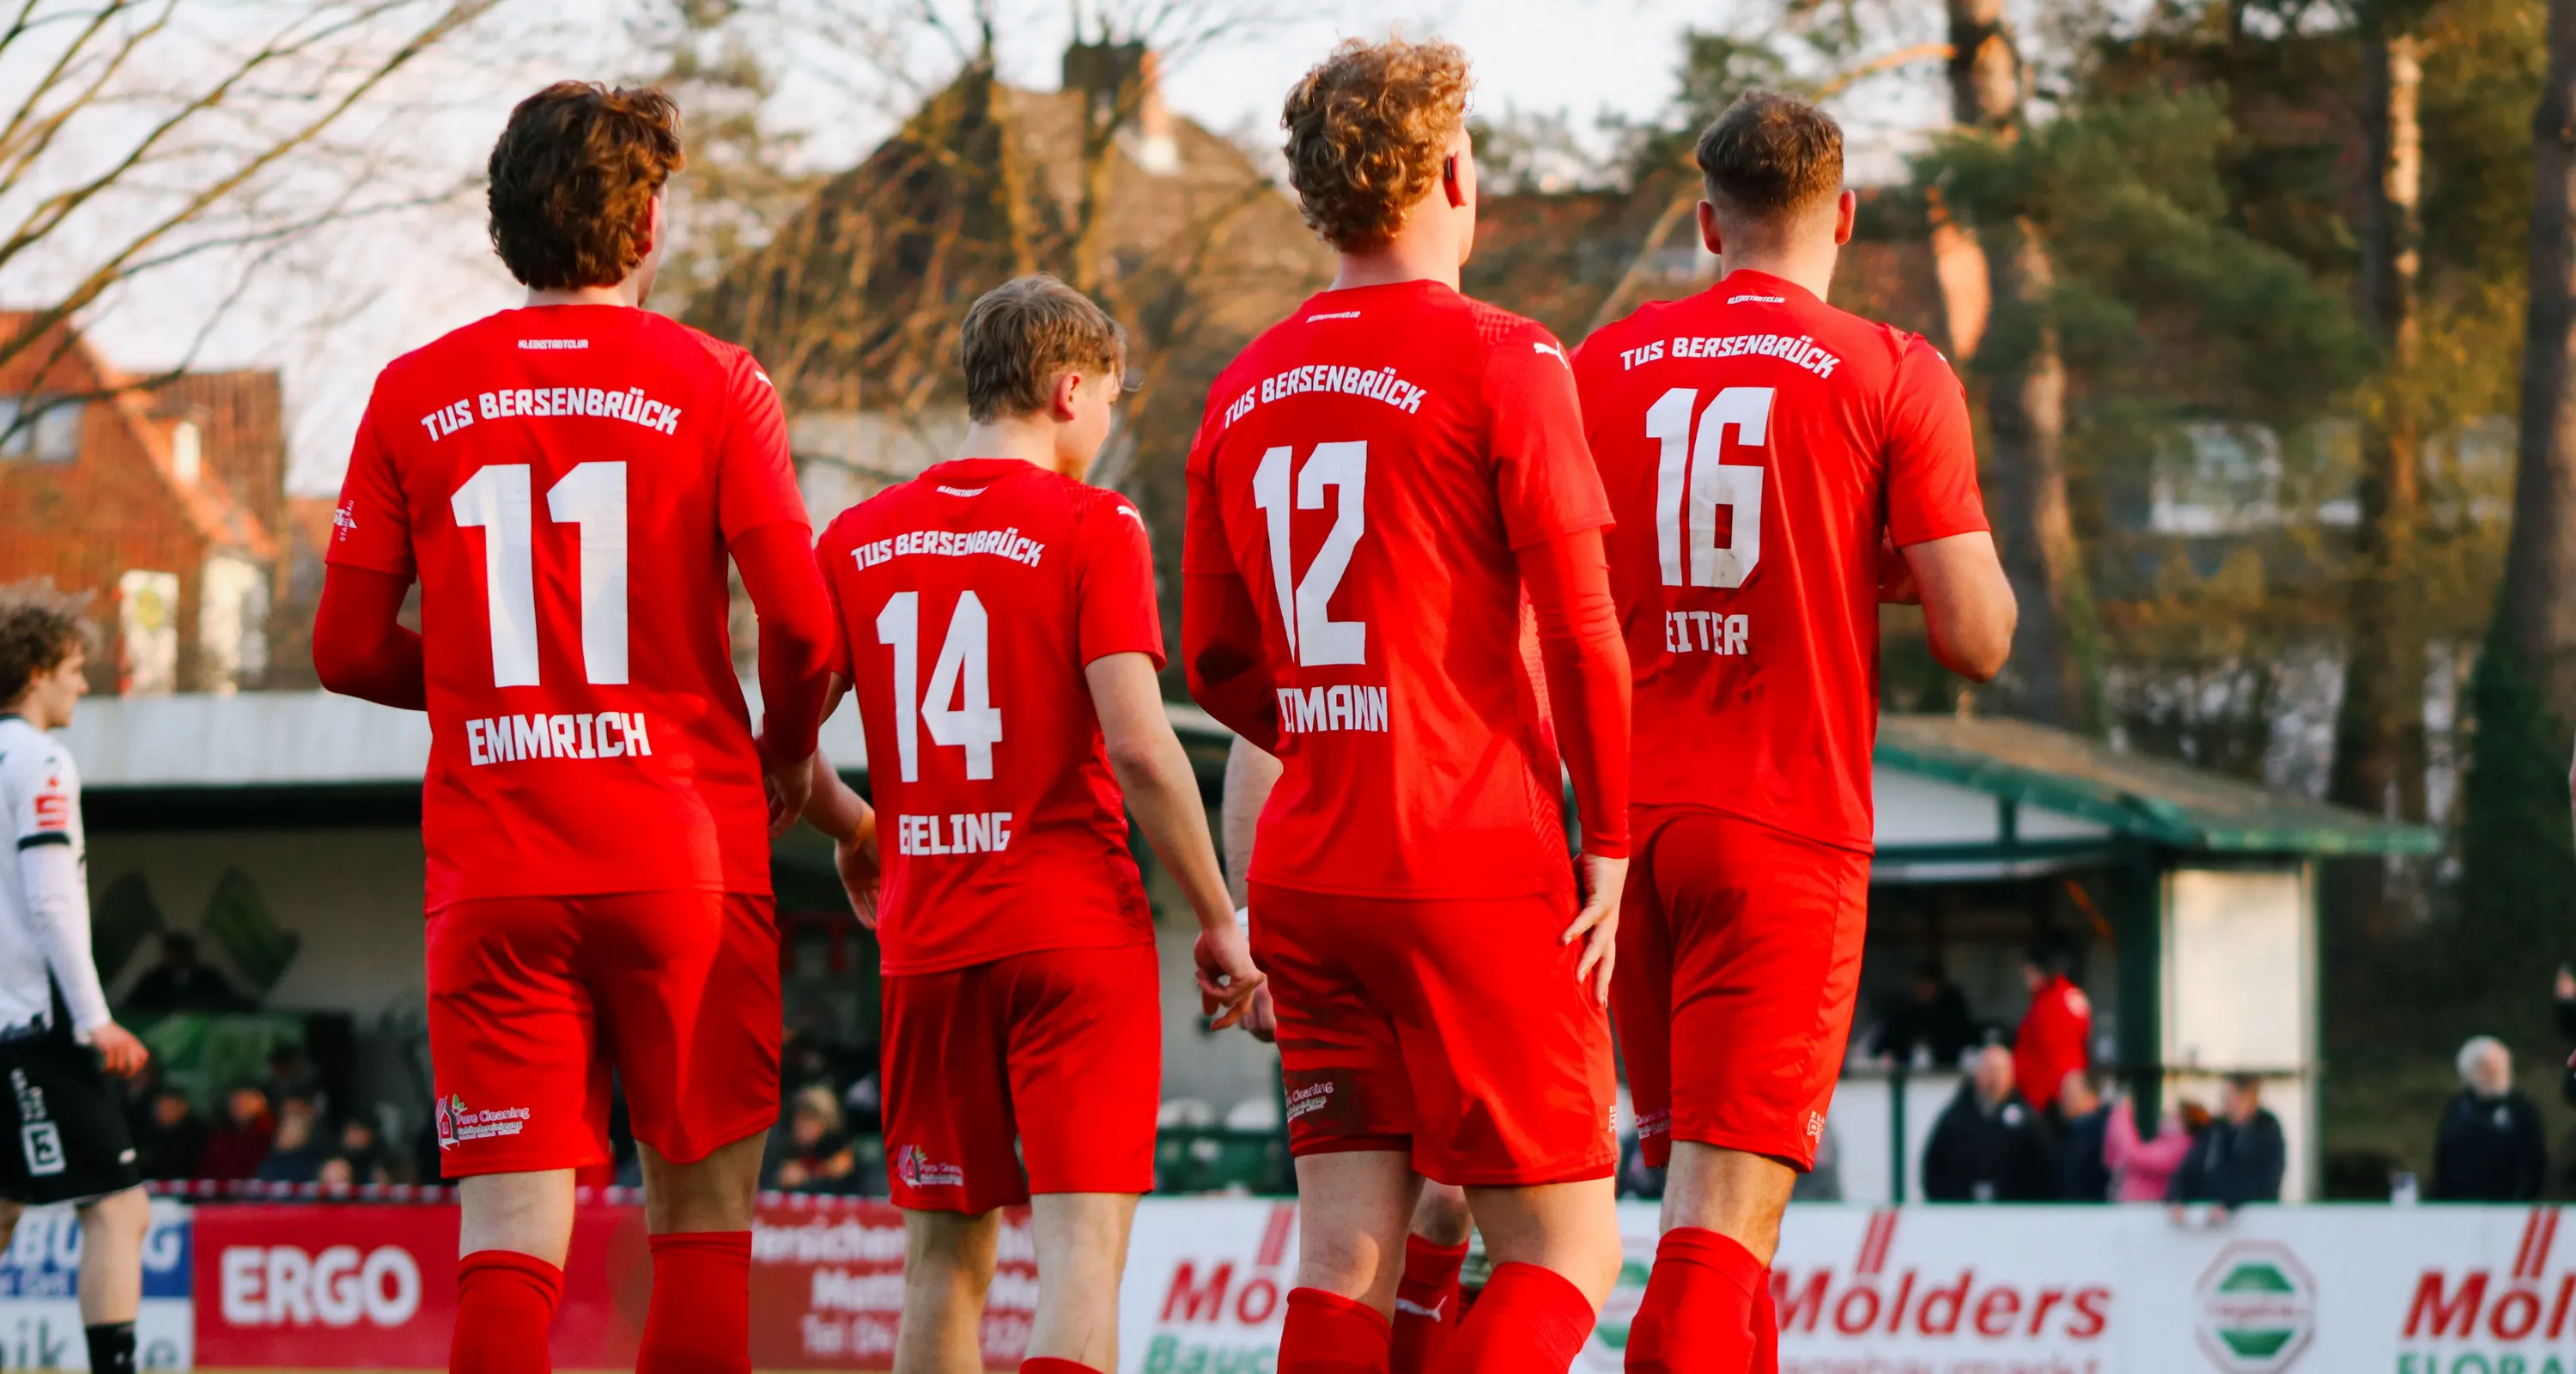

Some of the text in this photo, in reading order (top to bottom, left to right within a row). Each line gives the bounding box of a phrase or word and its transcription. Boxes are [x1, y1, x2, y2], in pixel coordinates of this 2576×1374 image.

[1619, 334, 1841, 380] TUS BERSENBRÜCK
[421, 386, 682, 442] TUS BERSENBRÜCK
[1224, 364, 1427, 429] TUS BERSENBRÜCK
[1645, 386, 1776, 588] 16
[450, 460, 629, 688] 11
[851, 526, 1045, 571] TUS BERSENBRÜCK
[1252, 440, 1368, 667] 12
[876, 590, 1003, 782] 14
[465, 711, 653, 766] EMMRICH
[479, 1107, 530, 1122] Cleaning
[221, 1246, 422, 1328] ERGO
